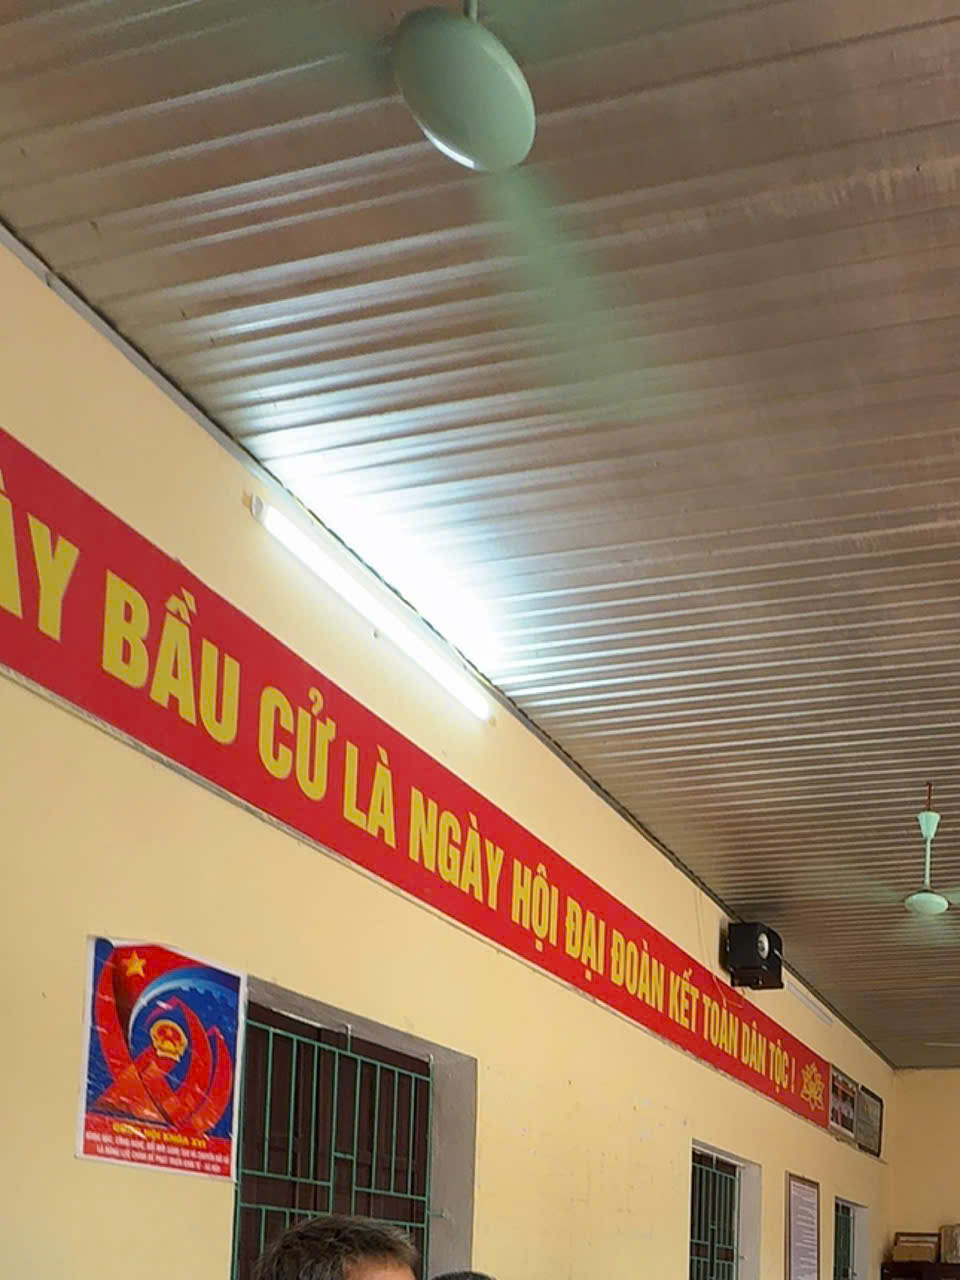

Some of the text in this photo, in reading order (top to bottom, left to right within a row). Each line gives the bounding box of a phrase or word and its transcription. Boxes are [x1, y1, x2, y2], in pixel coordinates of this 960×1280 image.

[102, 569, 240, 745] BẦU
[258, 685, 336, 801] CỬ
[343, 741, 397, 848] LÀ
[408, 786, 504, 911] NGÀY
[511, 859, 559, 952] HỘI
[565, 896, 605, 981] ĐẠI
[610, 929, 665, 1013] ĐOÀN
[669, 968, 700, 1033] KẾT
[702, 994, 740, 1059] TOÀN
[741, 1020, 767, 1076] DÂN
